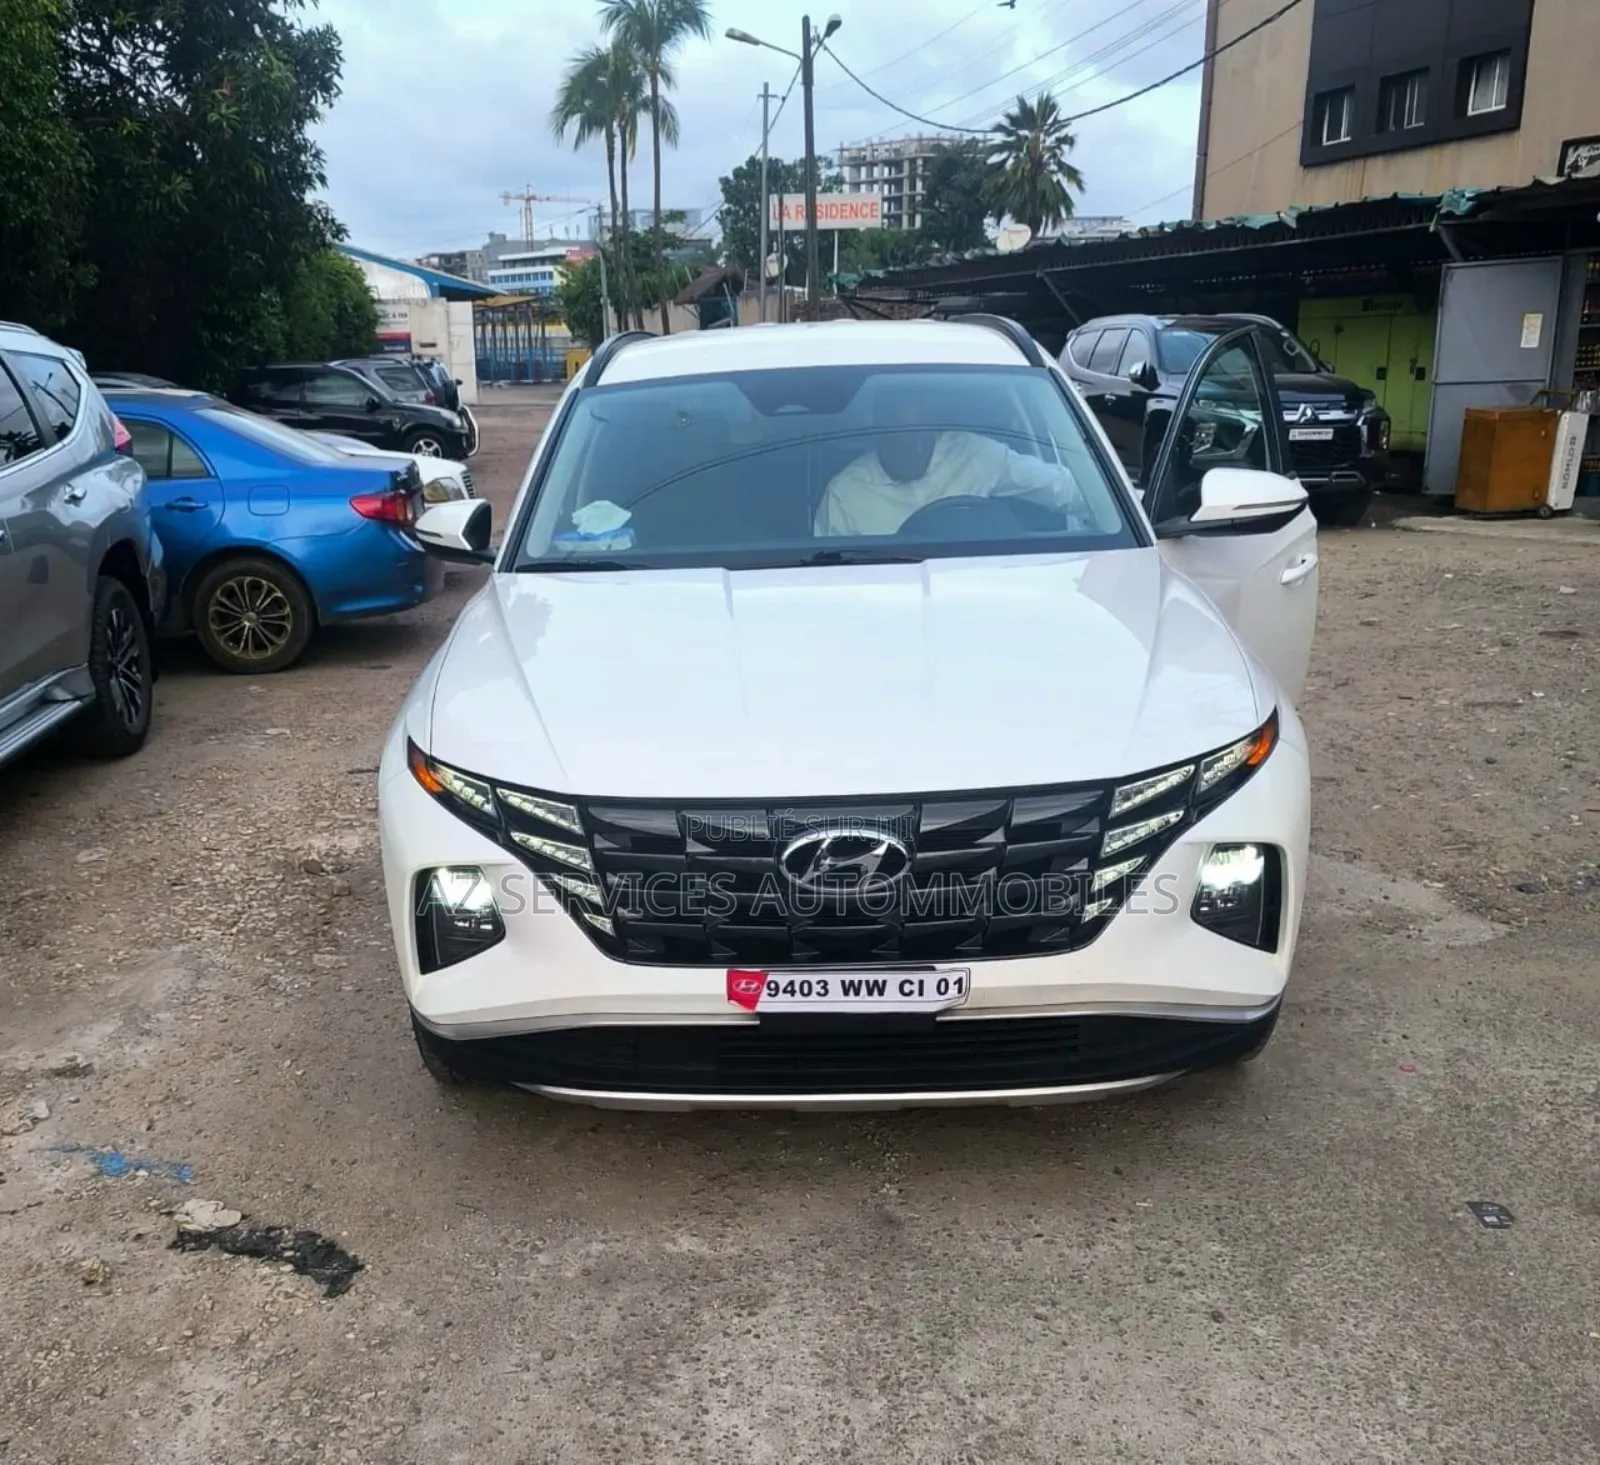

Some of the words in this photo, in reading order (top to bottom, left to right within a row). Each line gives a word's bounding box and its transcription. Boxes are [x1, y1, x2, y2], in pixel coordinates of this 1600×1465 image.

[773, 203, 792, 221] LA
[796, 202, 879, 220] RSIDENCE
[766, 979, 830, 998] 9403
[840, 979, 887, 997] WW
[898, 978, 925, 997] CI
[936, 977, 964, 996] 01
